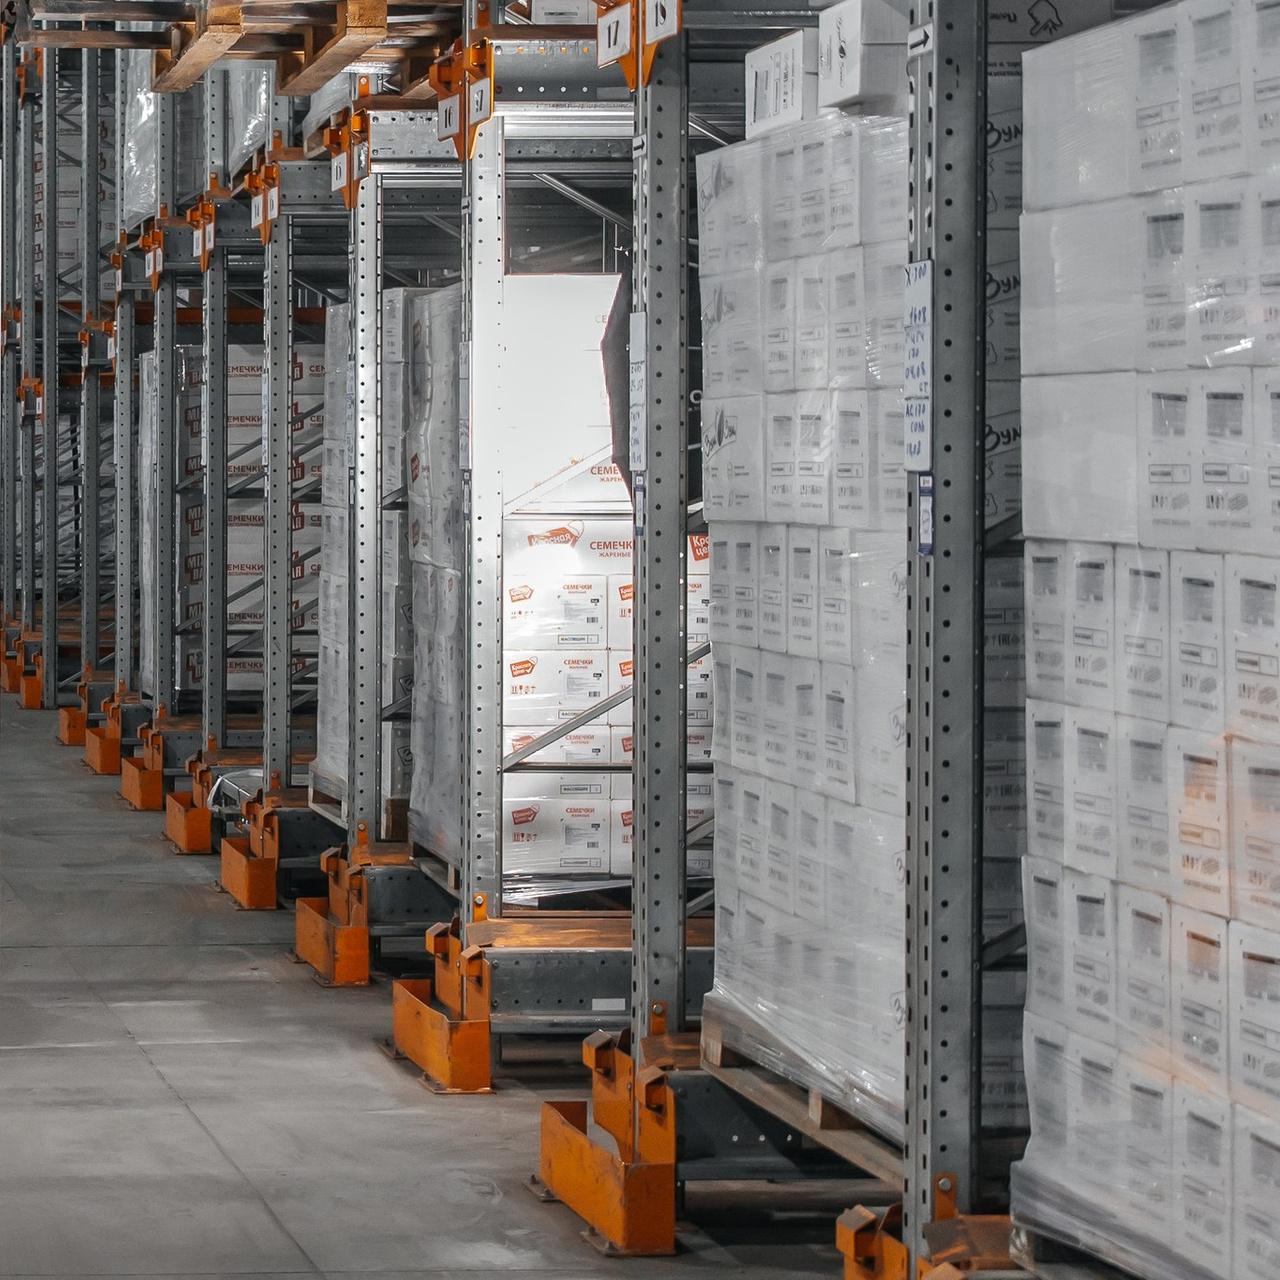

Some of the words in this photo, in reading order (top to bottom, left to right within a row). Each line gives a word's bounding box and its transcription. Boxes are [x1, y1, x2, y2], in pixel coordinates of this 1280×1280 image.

[607, 20, 619, 48] 17
[590, 466, 620, 475] СЕМЕ
[590, 542, 632, 550] СЕМЕЧК
